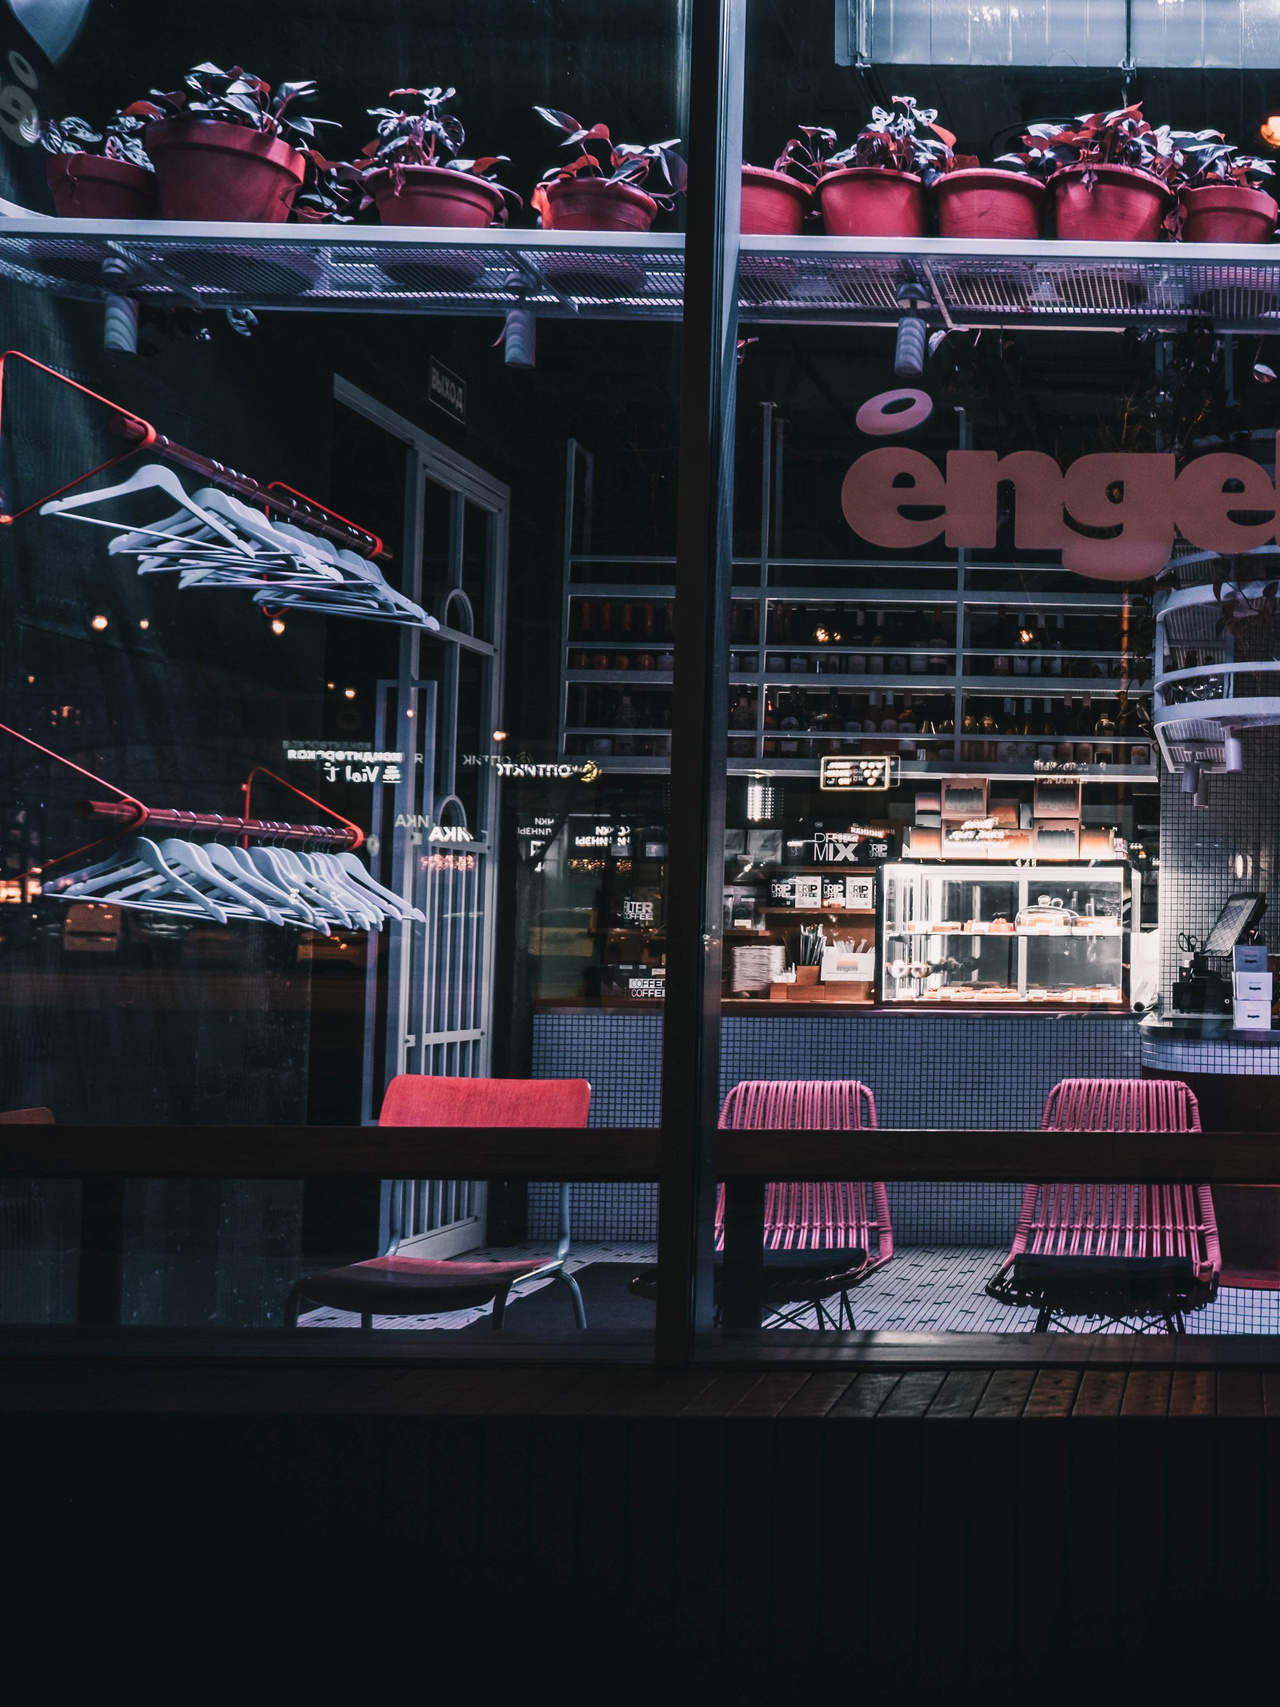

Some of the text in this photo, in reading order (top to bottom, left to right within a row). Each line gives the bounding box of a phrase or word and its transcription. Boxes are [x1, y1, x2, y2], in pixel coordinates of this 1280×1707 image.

[431, 366, 464, 414] ВЫХОД
[771, 883, 791, 892] DRIP
[798, 884, 818, 892] DRIP
[823, 884, 844, 892] DRIP
[849, 884, 869, 892] DRIP
[623, 912, 654, 920] COFFEE
[631, 980, 665, 988] COFFE
